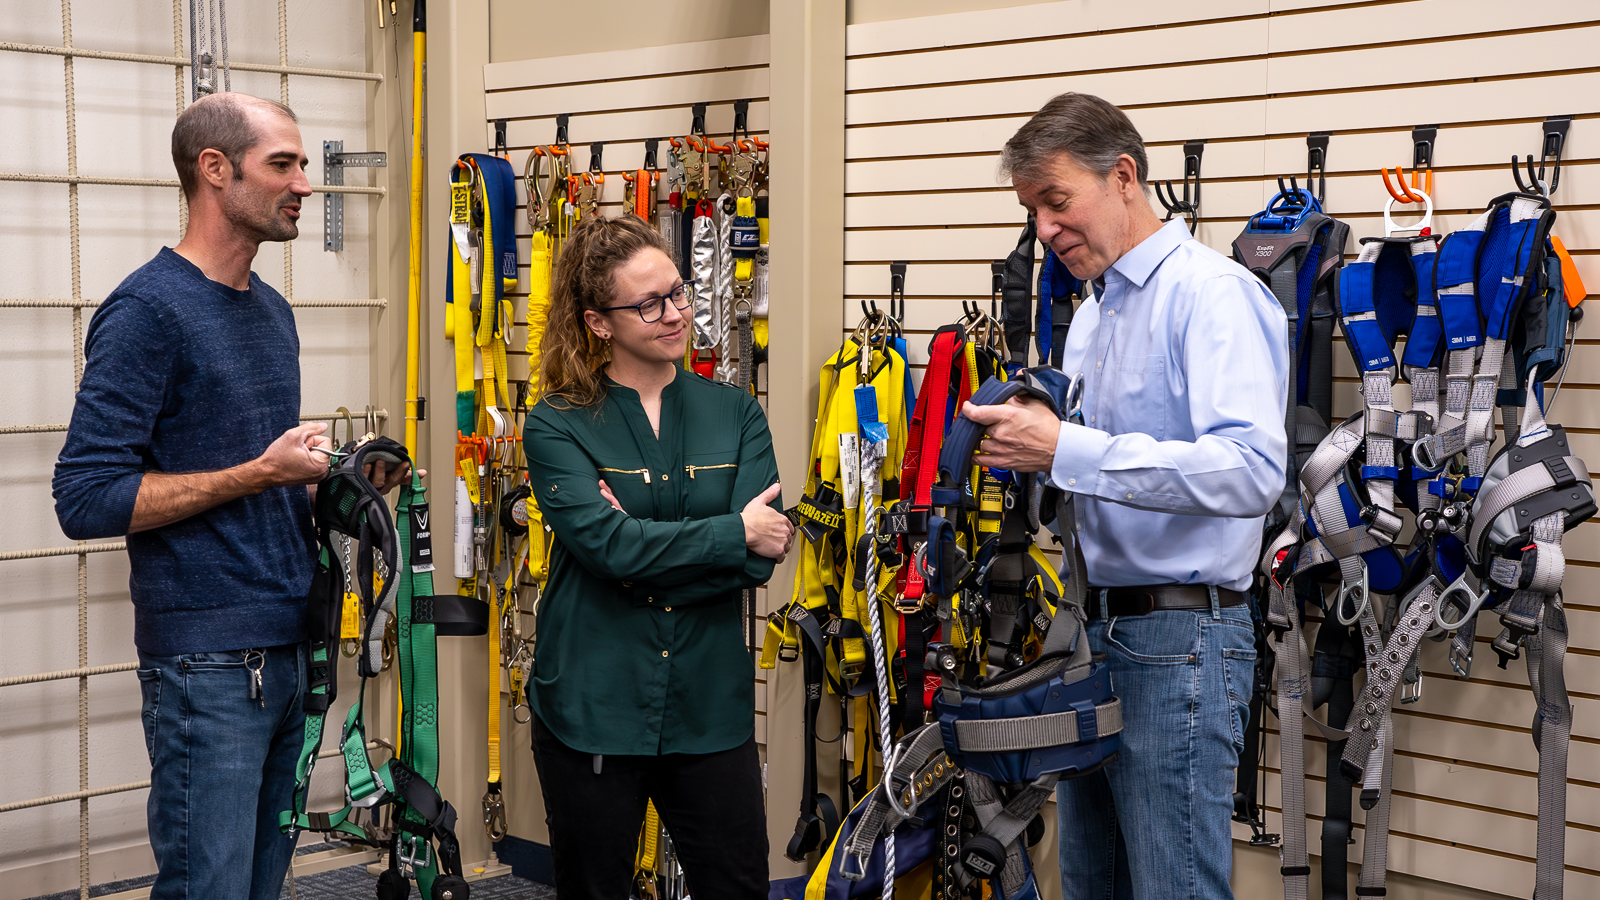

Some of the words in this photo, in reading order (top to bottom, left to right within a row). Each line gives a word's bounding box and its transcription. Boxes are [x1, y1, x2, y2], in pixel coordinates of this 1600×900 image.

[1451, 336, 1463, 344] 3M
[1368, 358, 1379, 366] 3M
[969, 855, 992, 872] SALA
